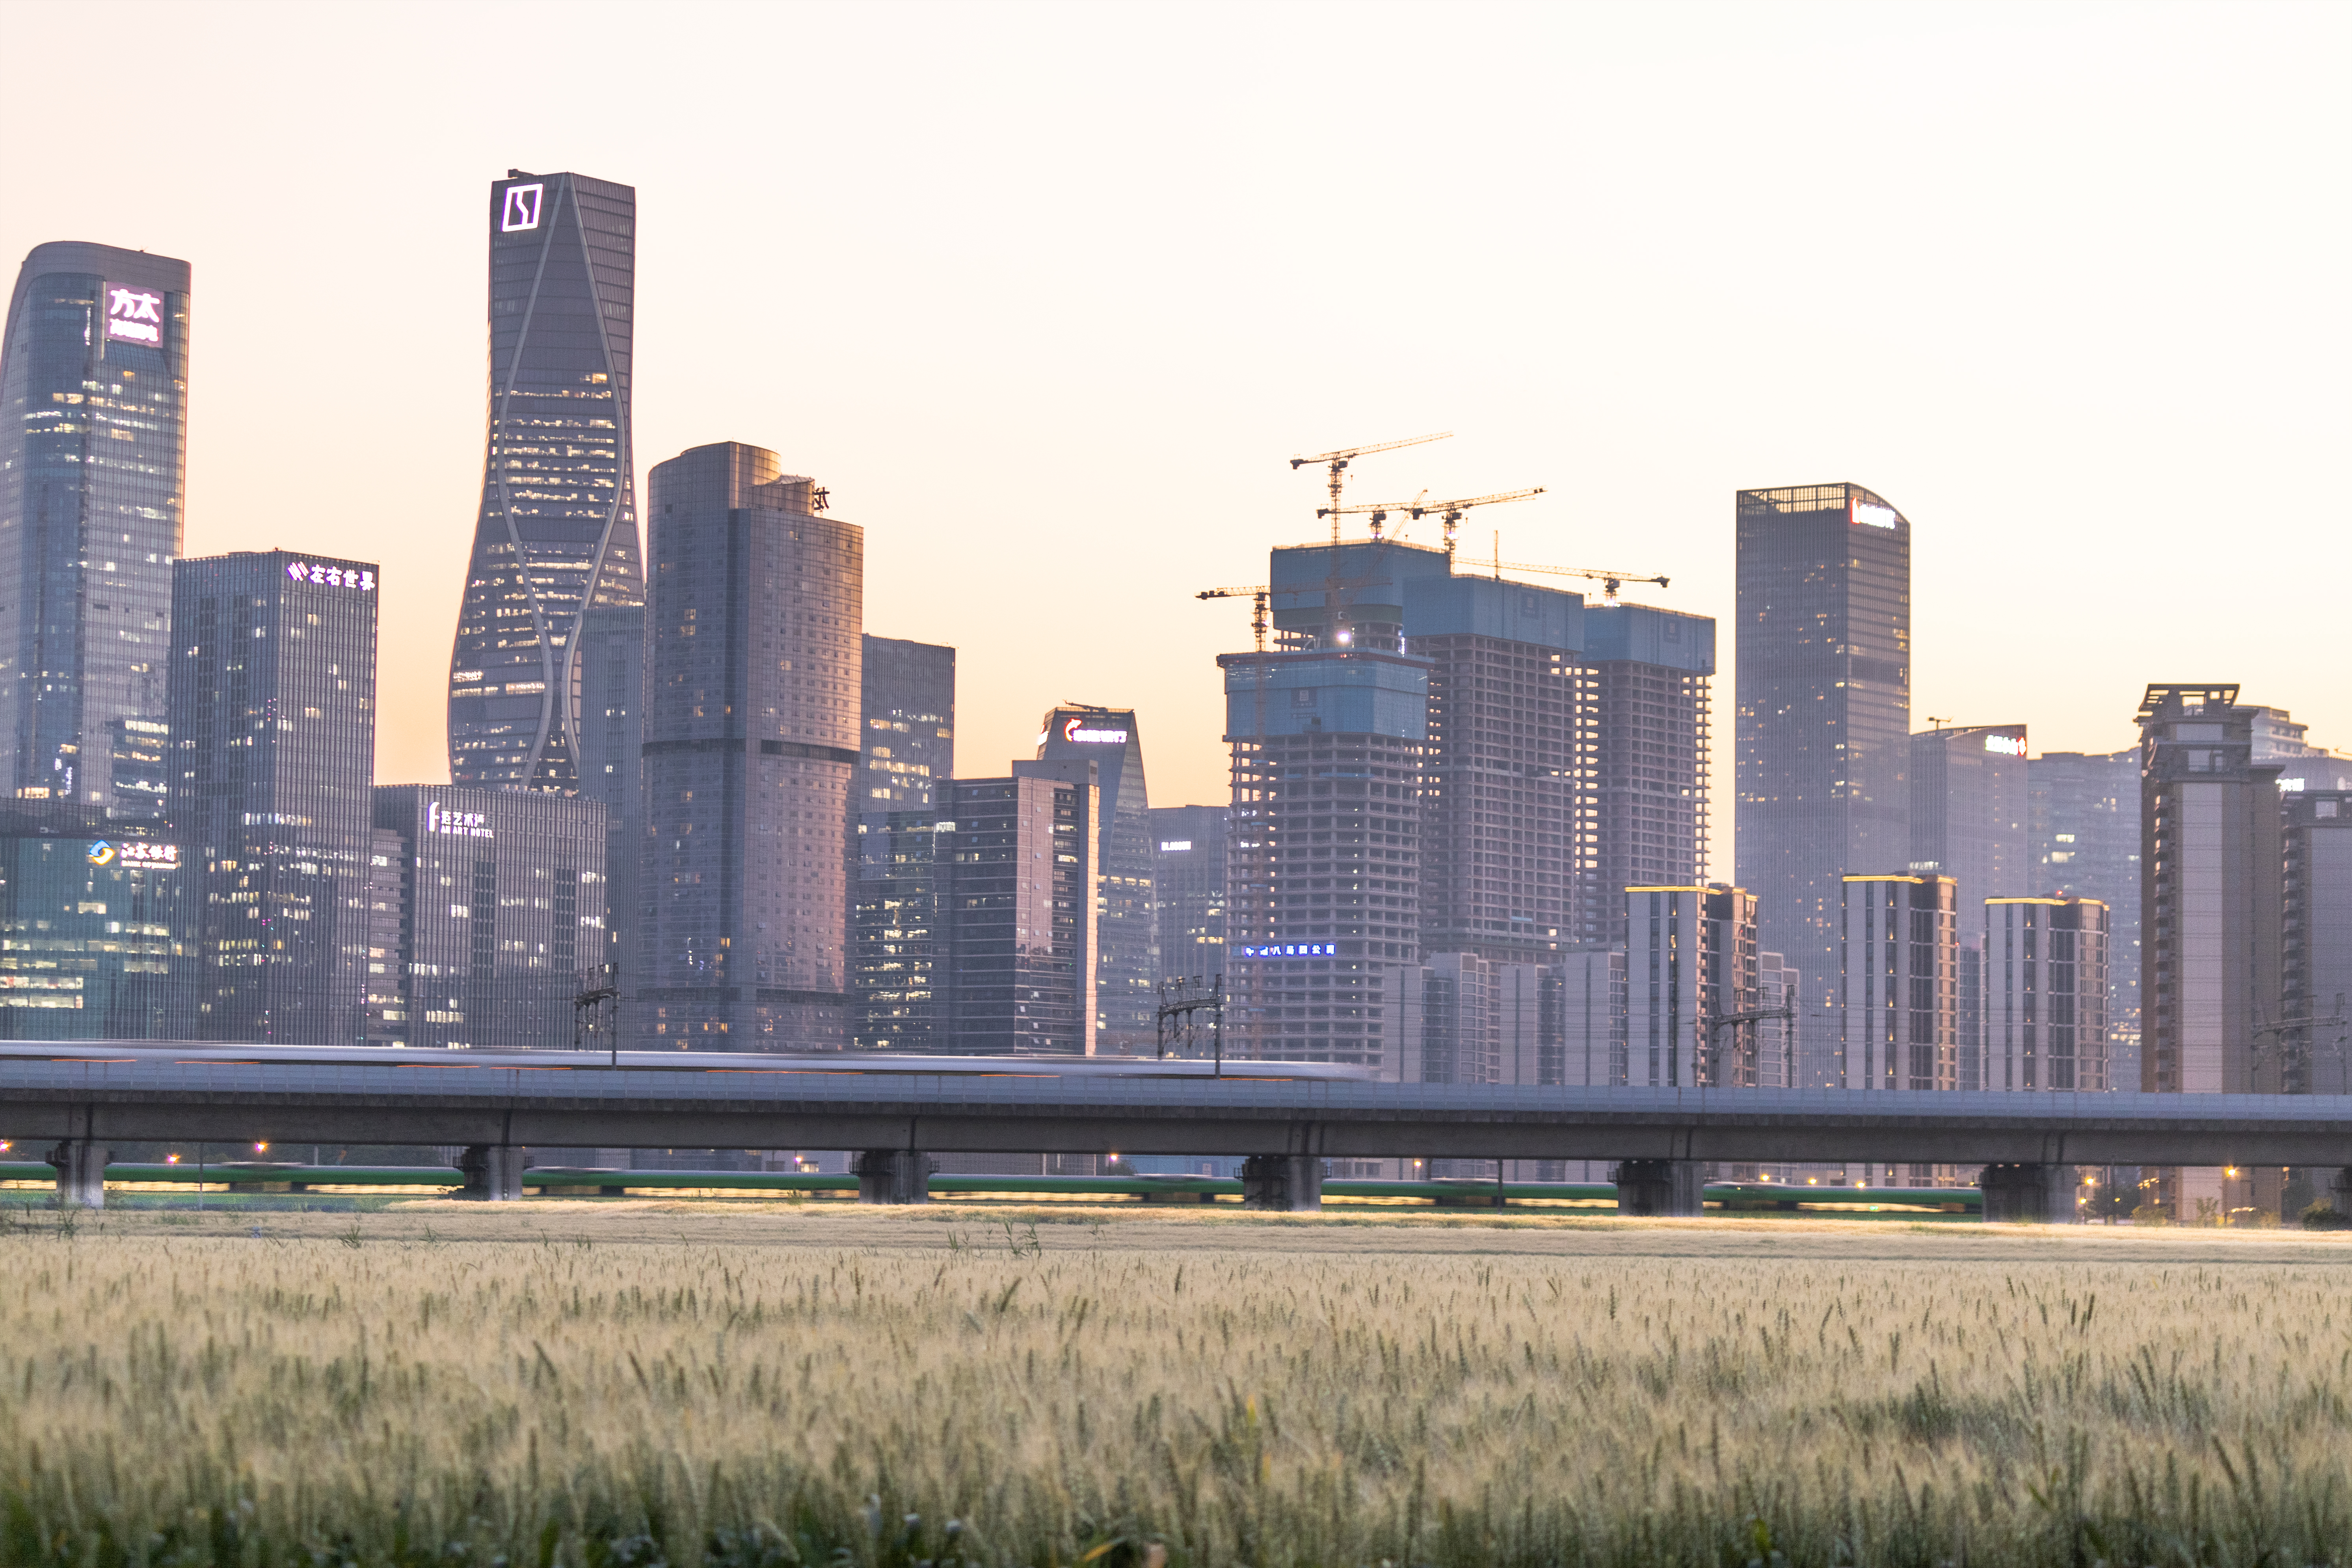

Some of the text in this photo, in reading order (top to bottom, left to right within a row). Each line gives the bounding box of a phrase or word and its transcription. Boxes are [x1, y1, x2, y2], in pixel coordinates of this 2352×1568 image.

[110, 288, 161, 323] 方太
[310, 564, 375, 591] 左右世界
[440, 824, 494, 839] AN ART HOTEL
